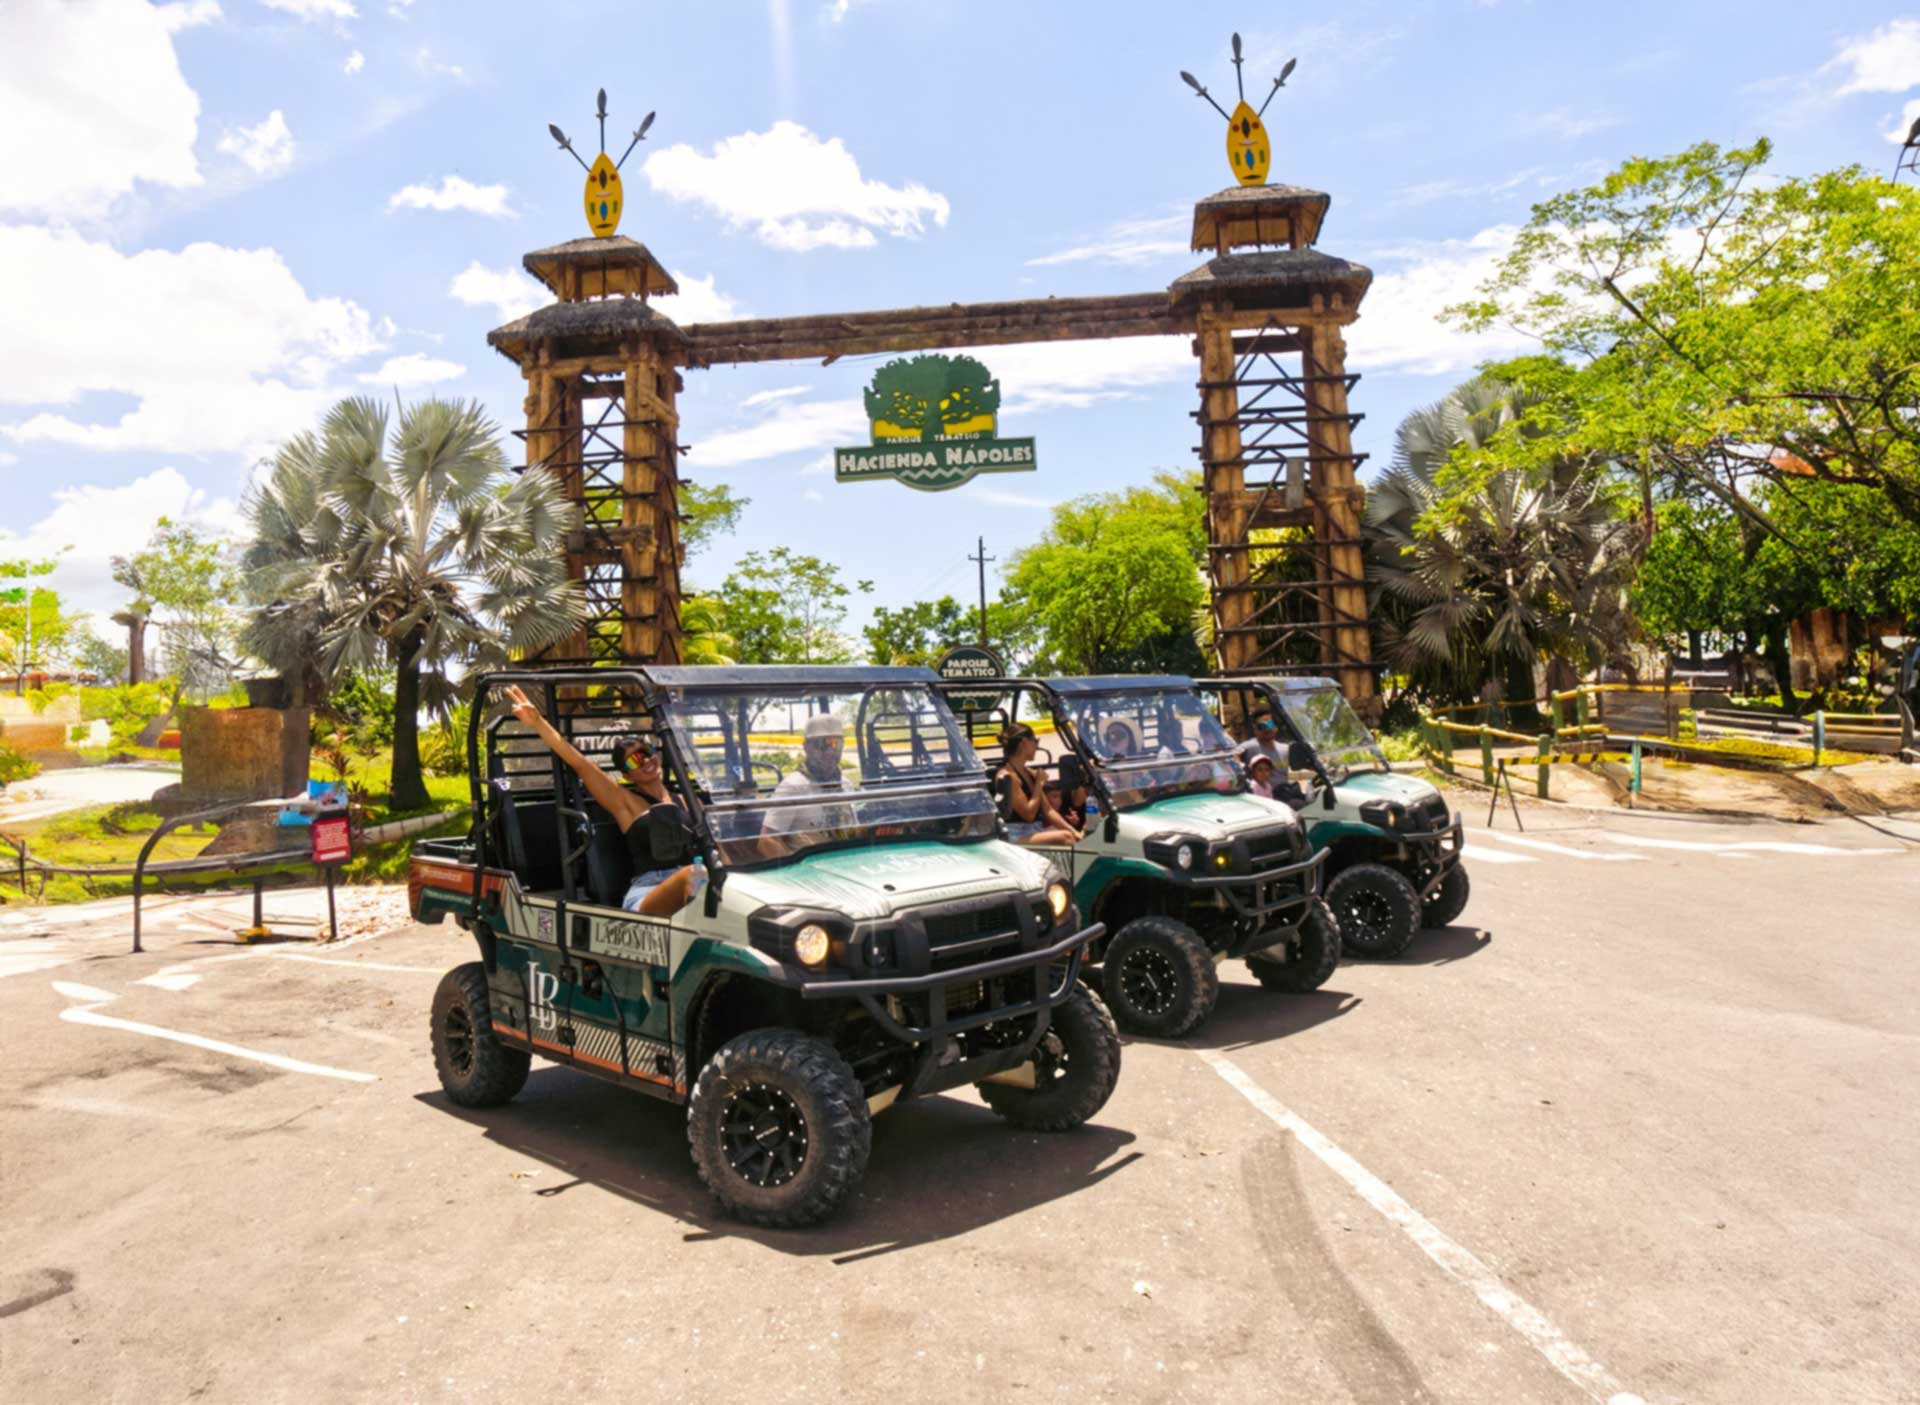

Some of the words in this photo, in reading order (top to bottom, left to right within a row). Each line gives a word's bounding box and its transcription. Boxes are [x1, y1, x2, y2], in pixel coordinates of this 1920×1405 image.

[886, 436, 922, 444] PARQUE
[839, 451, 938, 473] HACIENDA
[946, 444, 1033, 466] NÁPOLES
[947, 659, 990, 668] PARQUE
[942, 667, 997, 677] TEMATICO
